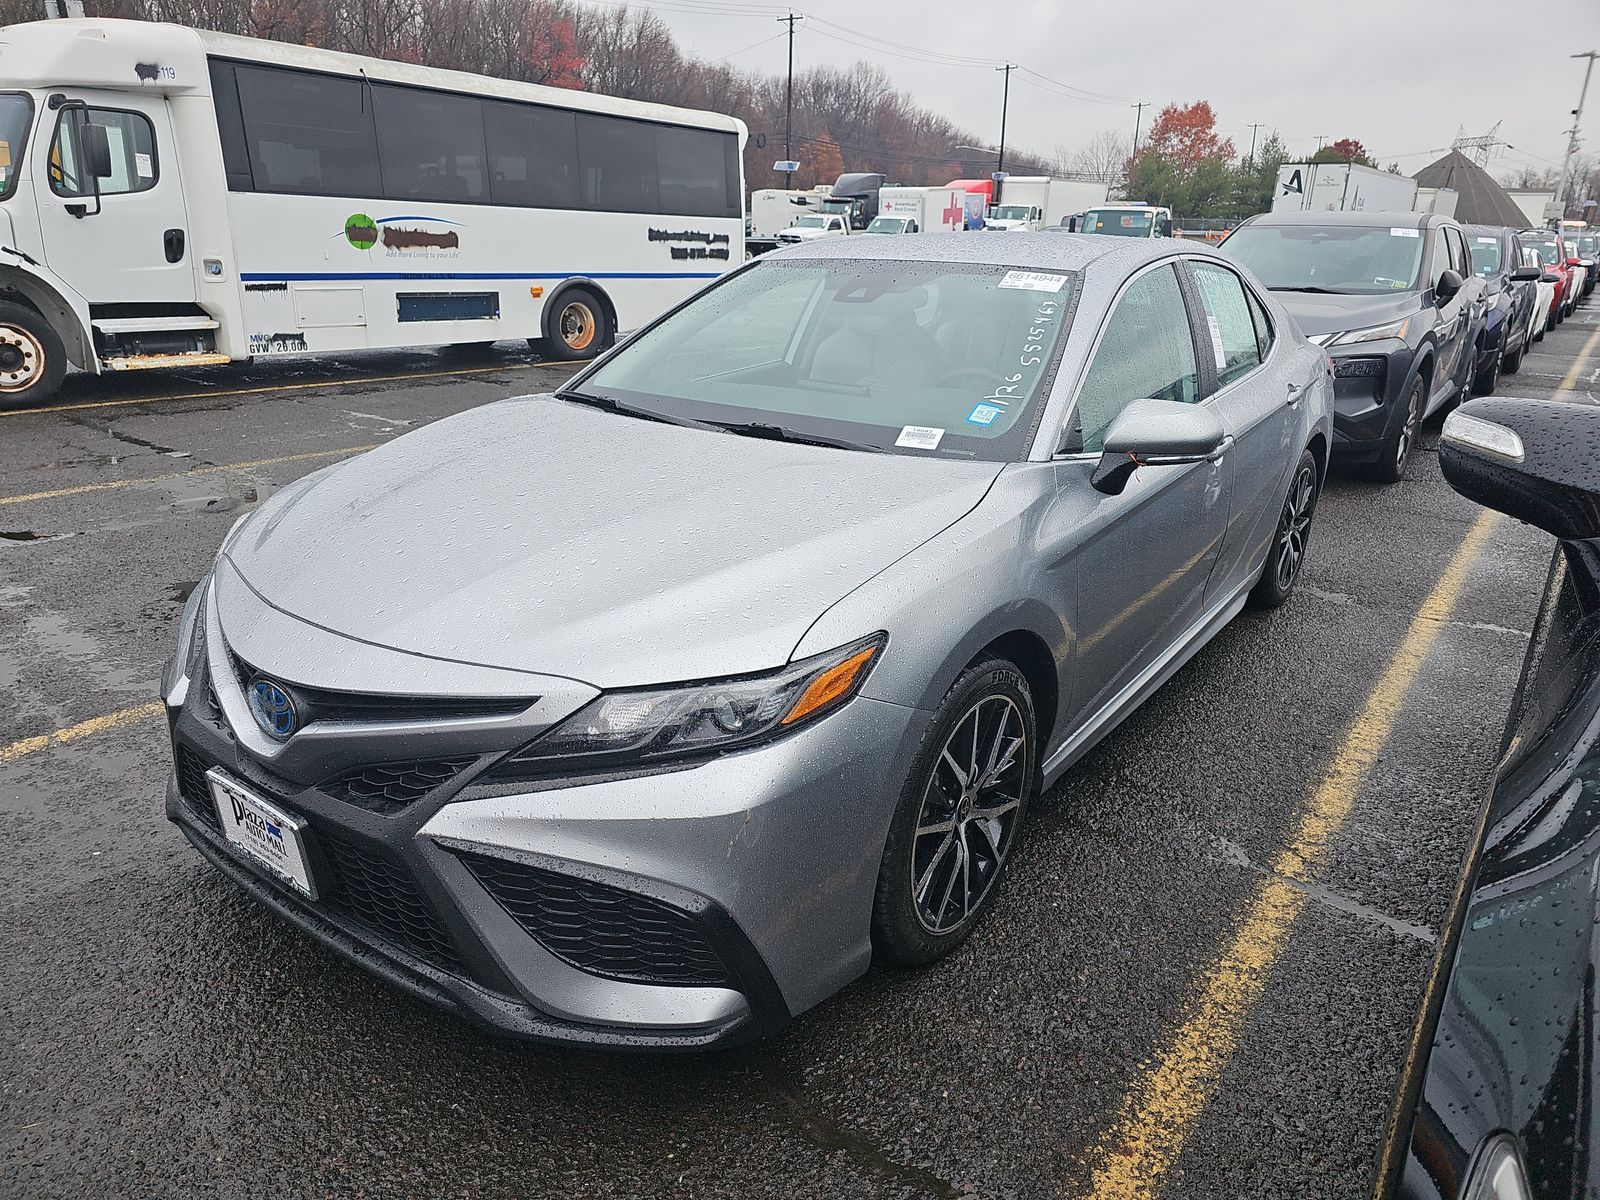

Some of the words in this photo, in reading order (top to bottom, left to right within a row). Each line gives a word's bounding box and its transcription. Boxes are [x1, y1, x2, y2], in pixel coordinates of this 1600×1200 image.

[386, 250, 398, 258] Add
[413, 250, 429, 259] Living
[230, 794, 266, 831] Plaza
[245, 820, 266, 842] AUTO
[265, 833, 289, 857] MALL
